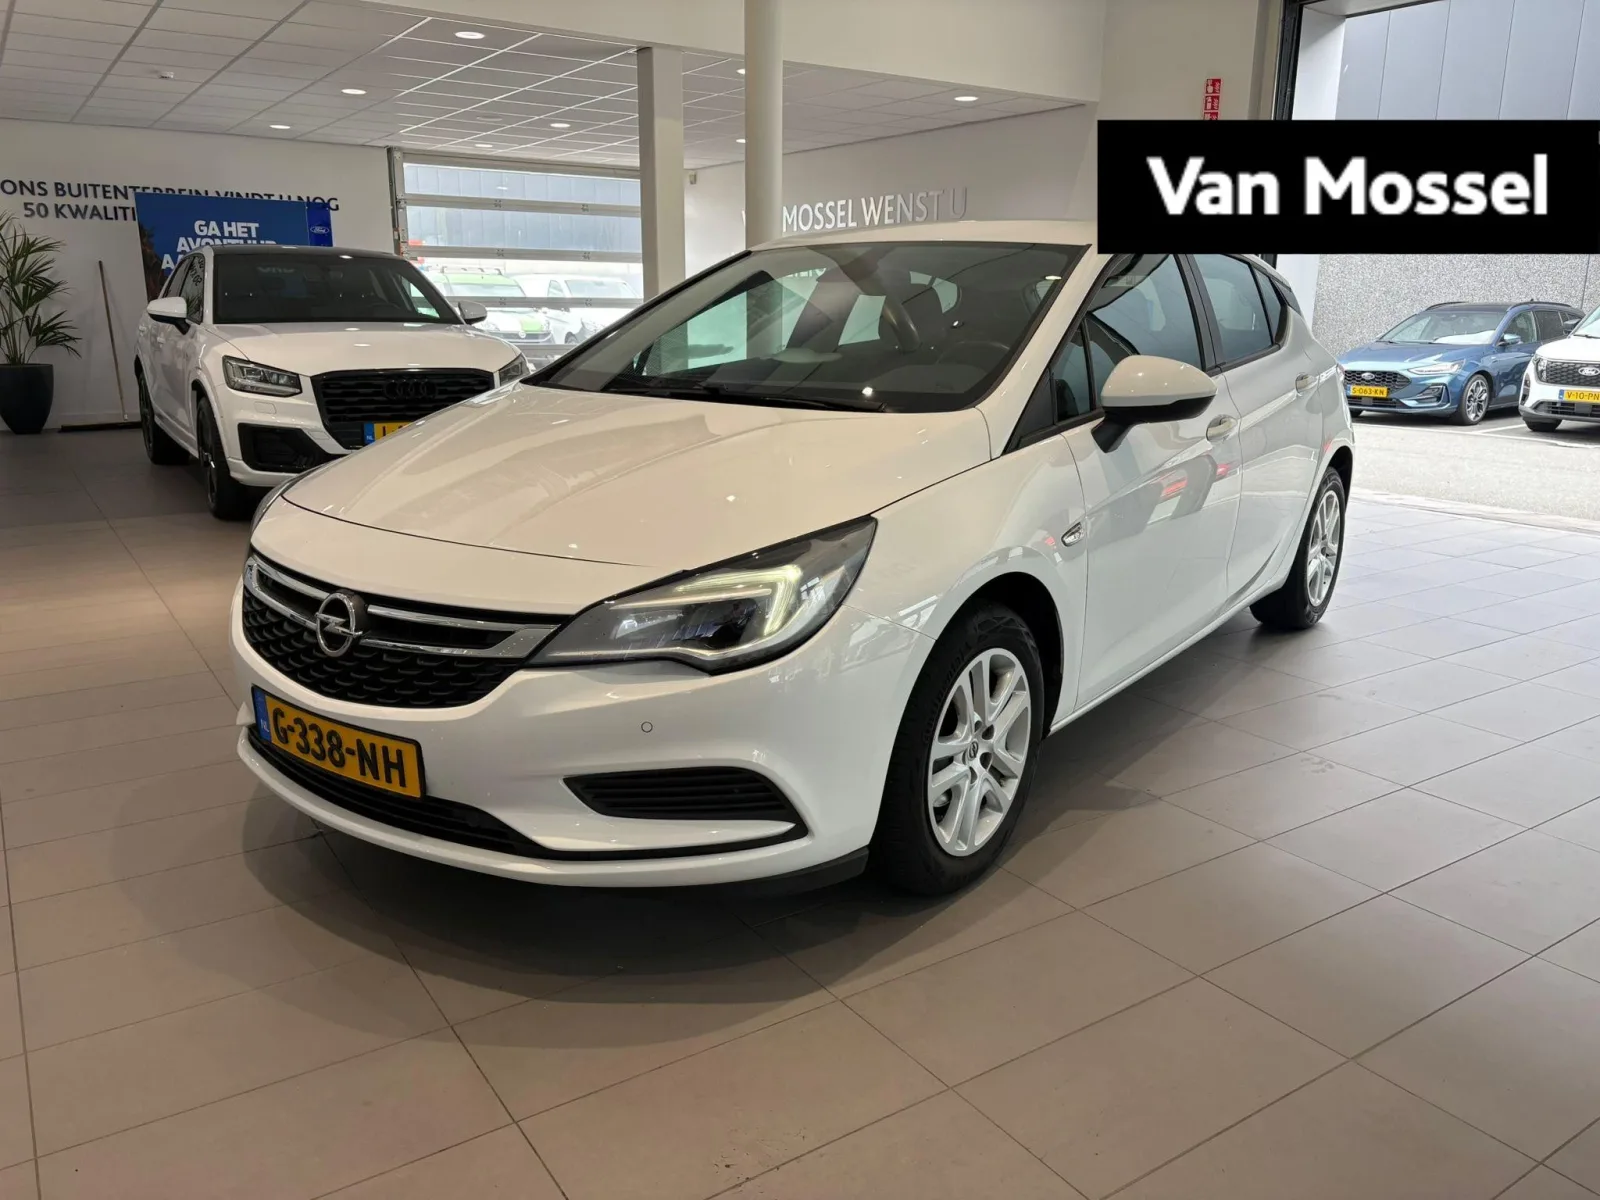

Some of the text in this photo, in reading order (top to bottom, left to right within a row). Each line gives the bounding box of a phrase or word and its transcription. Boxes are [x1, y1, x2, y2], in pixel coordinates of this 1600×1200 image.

[0, 179, 48, 197] ONS
[23, 202, 49, 218] 50
[782, 199, 858, 232] MOSSEL
[860, 190, 945, 226] WENST
[949, 187, 968, 220] U
[194, 220, 260, 238] GA HET
[272, 706, 407, 788] G-338-NH
